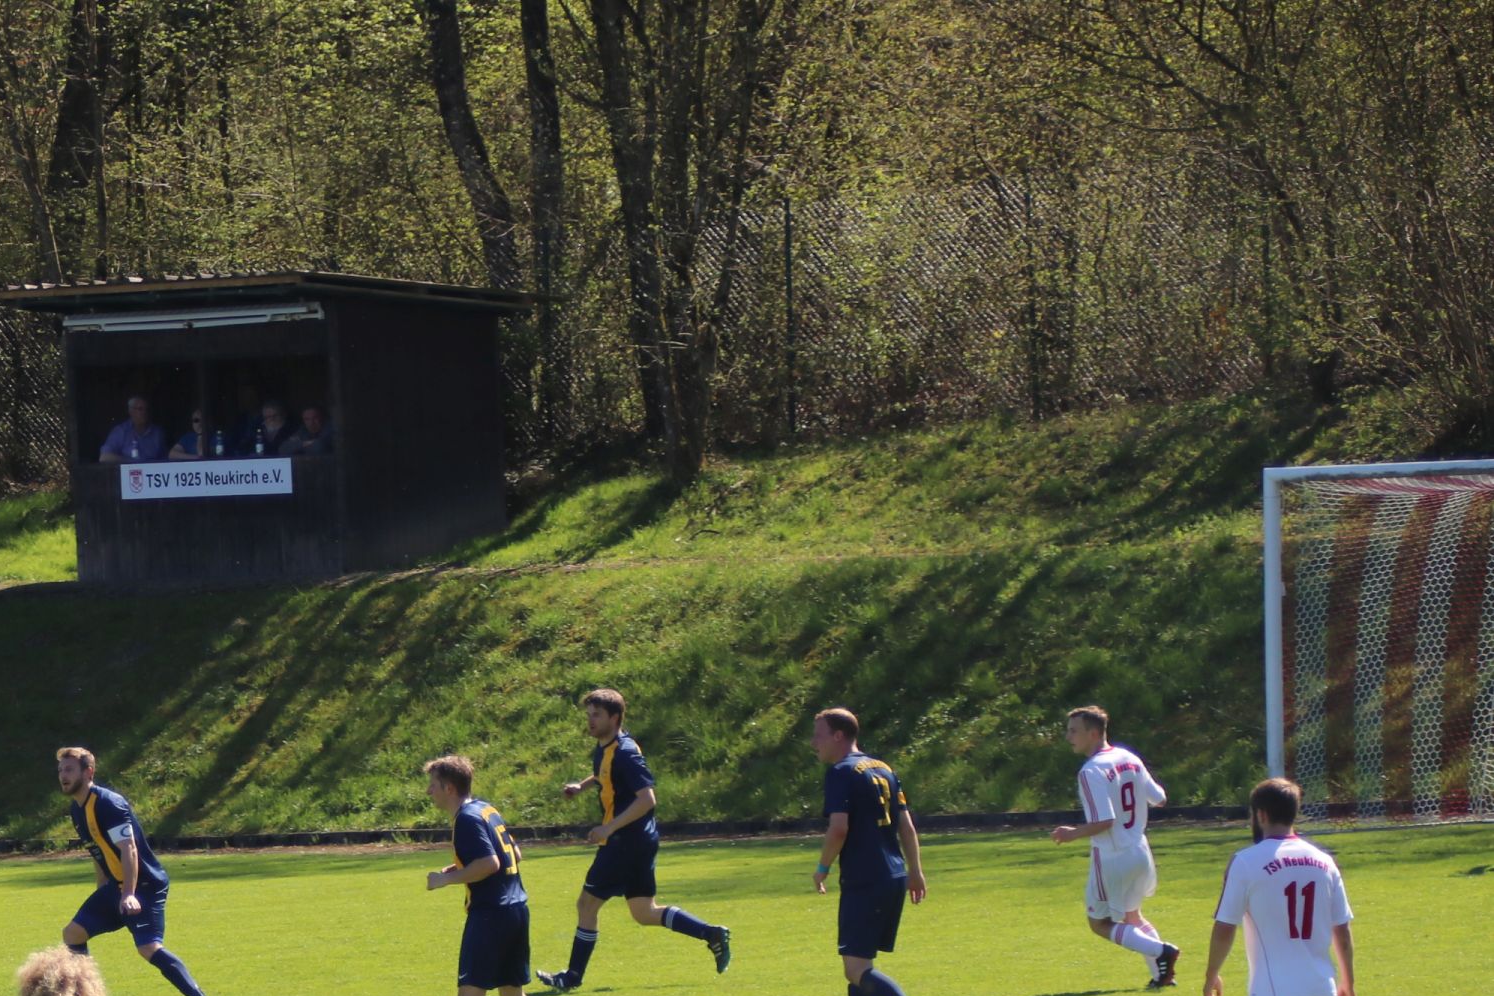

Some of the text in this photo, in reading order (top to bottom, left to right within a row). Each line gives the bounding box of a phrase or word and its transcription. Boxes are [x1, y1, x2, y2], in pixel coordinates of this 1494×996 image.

[146, 469, 283, 488] TSV 1925 Neukirch e.V.
[1121, 781, 1136, 829] 9
[1263, 856, 1329, 876] TSV Neukirch
[1284, 880, 1316, 940] 11
